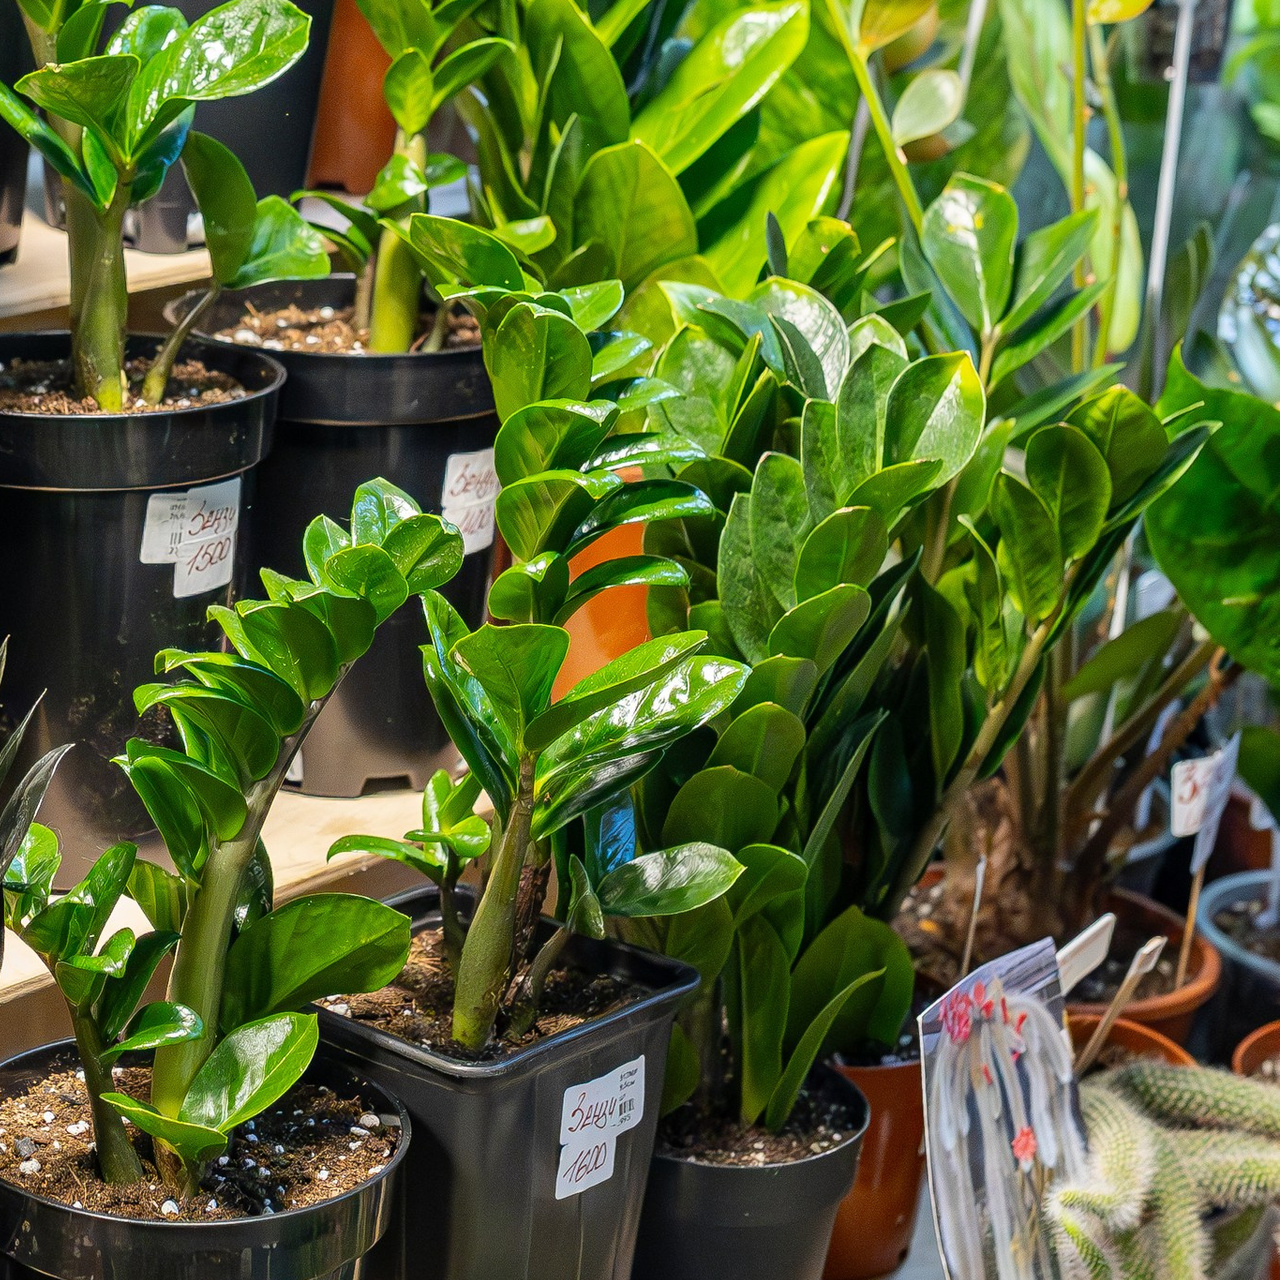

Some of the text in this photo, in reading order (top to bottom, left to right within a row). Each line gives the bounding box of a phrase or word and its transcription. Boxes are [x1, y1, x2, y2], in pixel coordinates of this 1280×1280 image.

[188, 500, 237, 536] Зензи
[187, 537, 232, 577] 1500
[568, 1091, 618, 1133] Зензи
[562, 1141, 607, 1184] 1600
